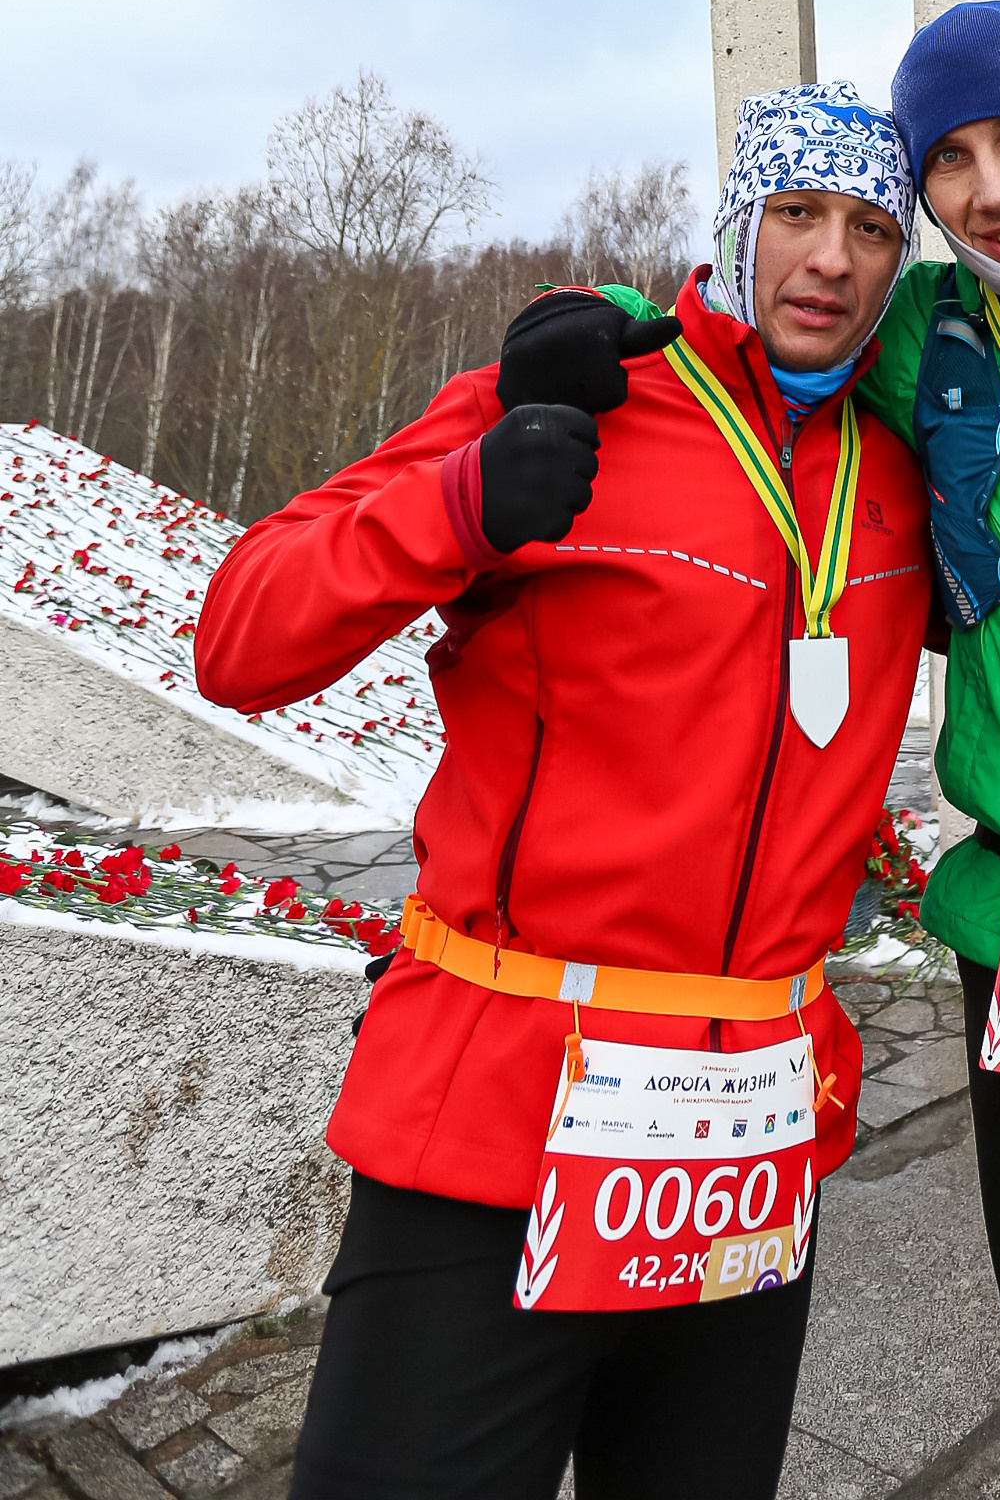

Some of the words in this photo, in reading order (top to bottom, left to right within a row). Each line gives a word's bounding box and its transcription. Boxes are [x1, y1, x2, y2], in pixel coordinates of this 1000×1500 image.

[806, 139, 833, 148] MAD
[835, 142, 859, 153] FOX
[860, 148, 893, 168] ULTRA
[586, 1074, 621, 1088] ГАЗПРОМ
[644, 1075, 711, 1092] ДОРОГА
[720, 1071, 777, 1093] ЖИЗНИ
[575, 1119, 590, 1128] tech
[601, 1120, 634, 1129] MARVEL
[593, 1160, 778, 1242] 0060
[718, 1235, 784, 1285] B10
